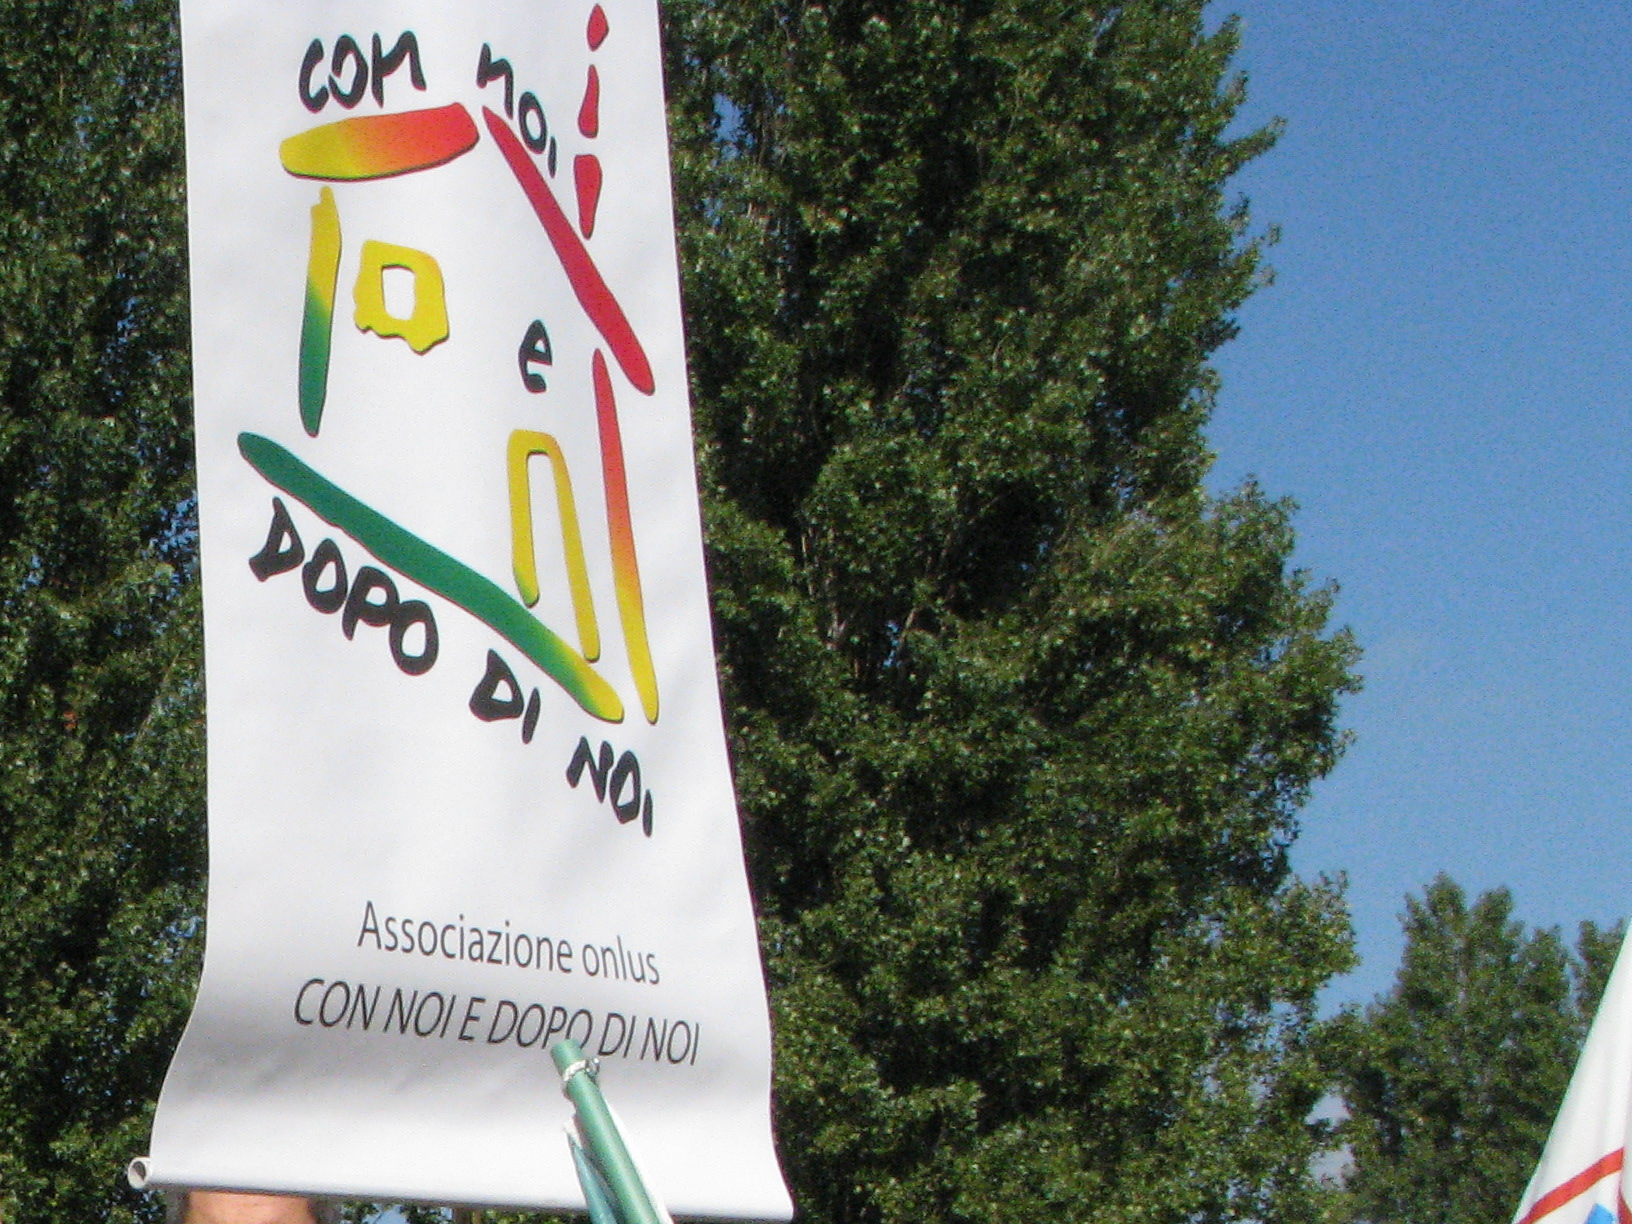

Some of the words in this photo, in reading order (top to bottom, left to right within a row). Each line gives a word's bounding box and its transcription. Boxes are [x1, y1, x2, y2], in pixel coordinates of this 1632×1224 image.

[518, 320, 553, 393] e
[248, 497, 439, 675] DOPO
[468, 648, 541, 745] DI
[566, 736, 654, 838] NOI
[357, 900, 574, 974] Associazione
[581, 934, 661, 985] onlus
[293, 978, 382, 1031] CON
[383, 989, 458, 1039] NOI
[458, 997, 487, 1042] E
[488, 1000, 593, 1051] DOPO
[598, 1012, 637, 1060] DI
[640, 1017, 701, 1067] NOI
